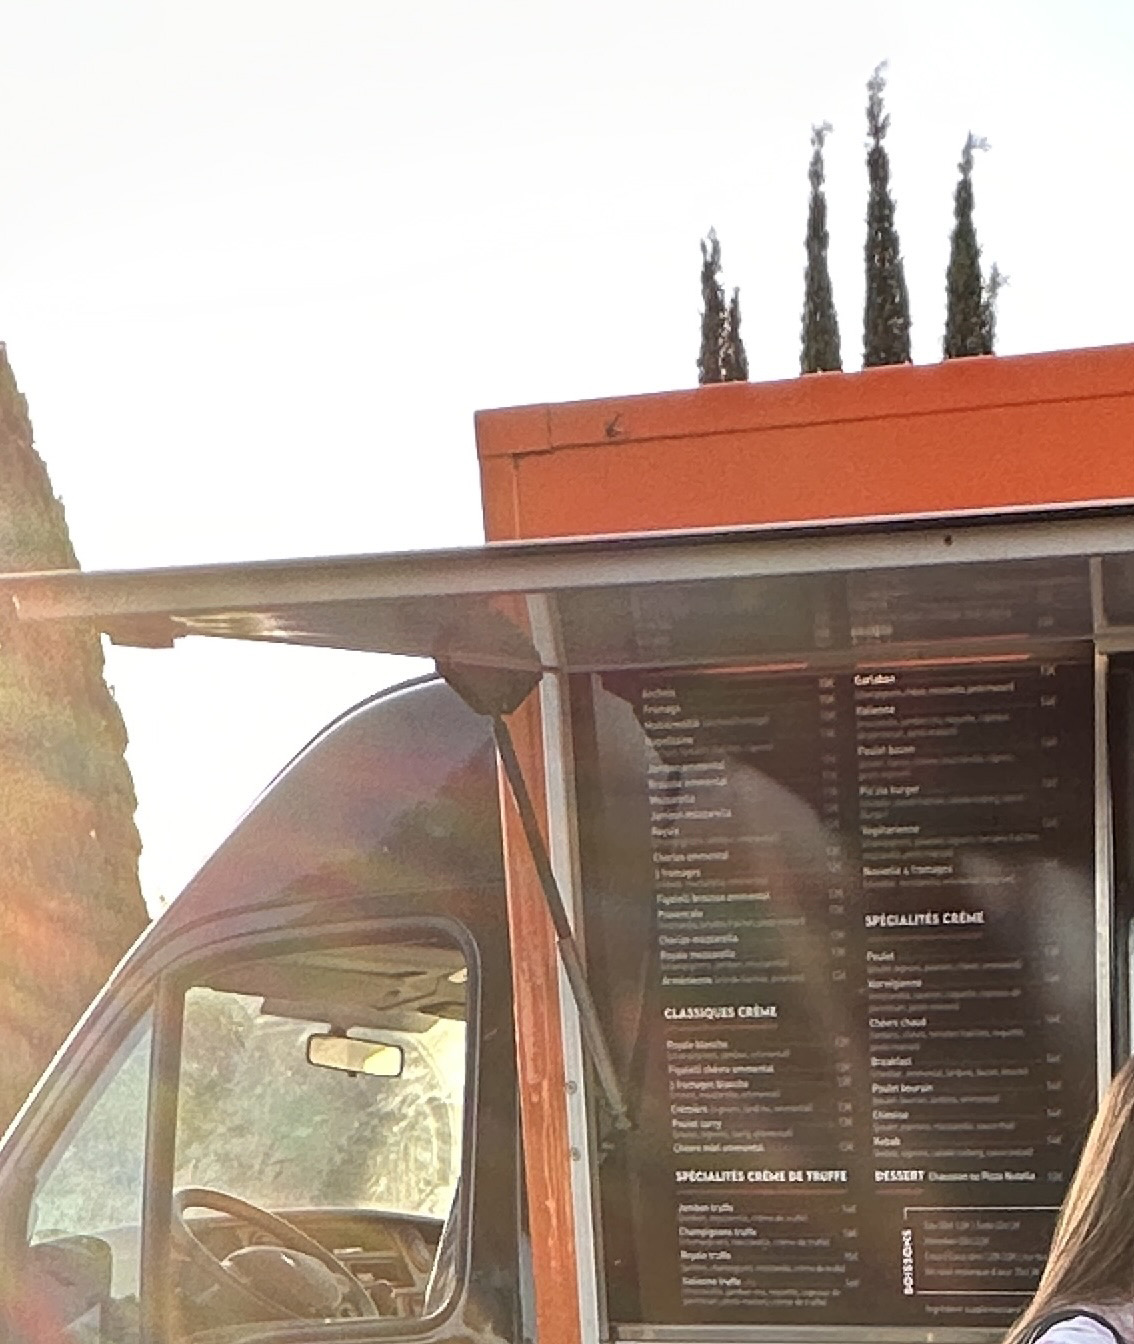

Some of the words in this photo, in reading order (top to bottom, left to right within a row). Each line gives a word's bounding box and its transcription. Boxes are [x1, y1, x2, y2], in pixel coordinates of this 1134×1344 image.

[865, 910, 939, 927] SPÉCIALITÉS
[664, 1007, 735, 1021] CLASSIQUES
[675, 1168, 744, 1182] SPÉCIALITÉS
[789, 1170, 803, 1182] DE
[806, 1170, 848, 1182] TRUFFE
[875, 1170, 925, 1181] DESSERT
[901, 1229, 914, 1295] BOISSONS
